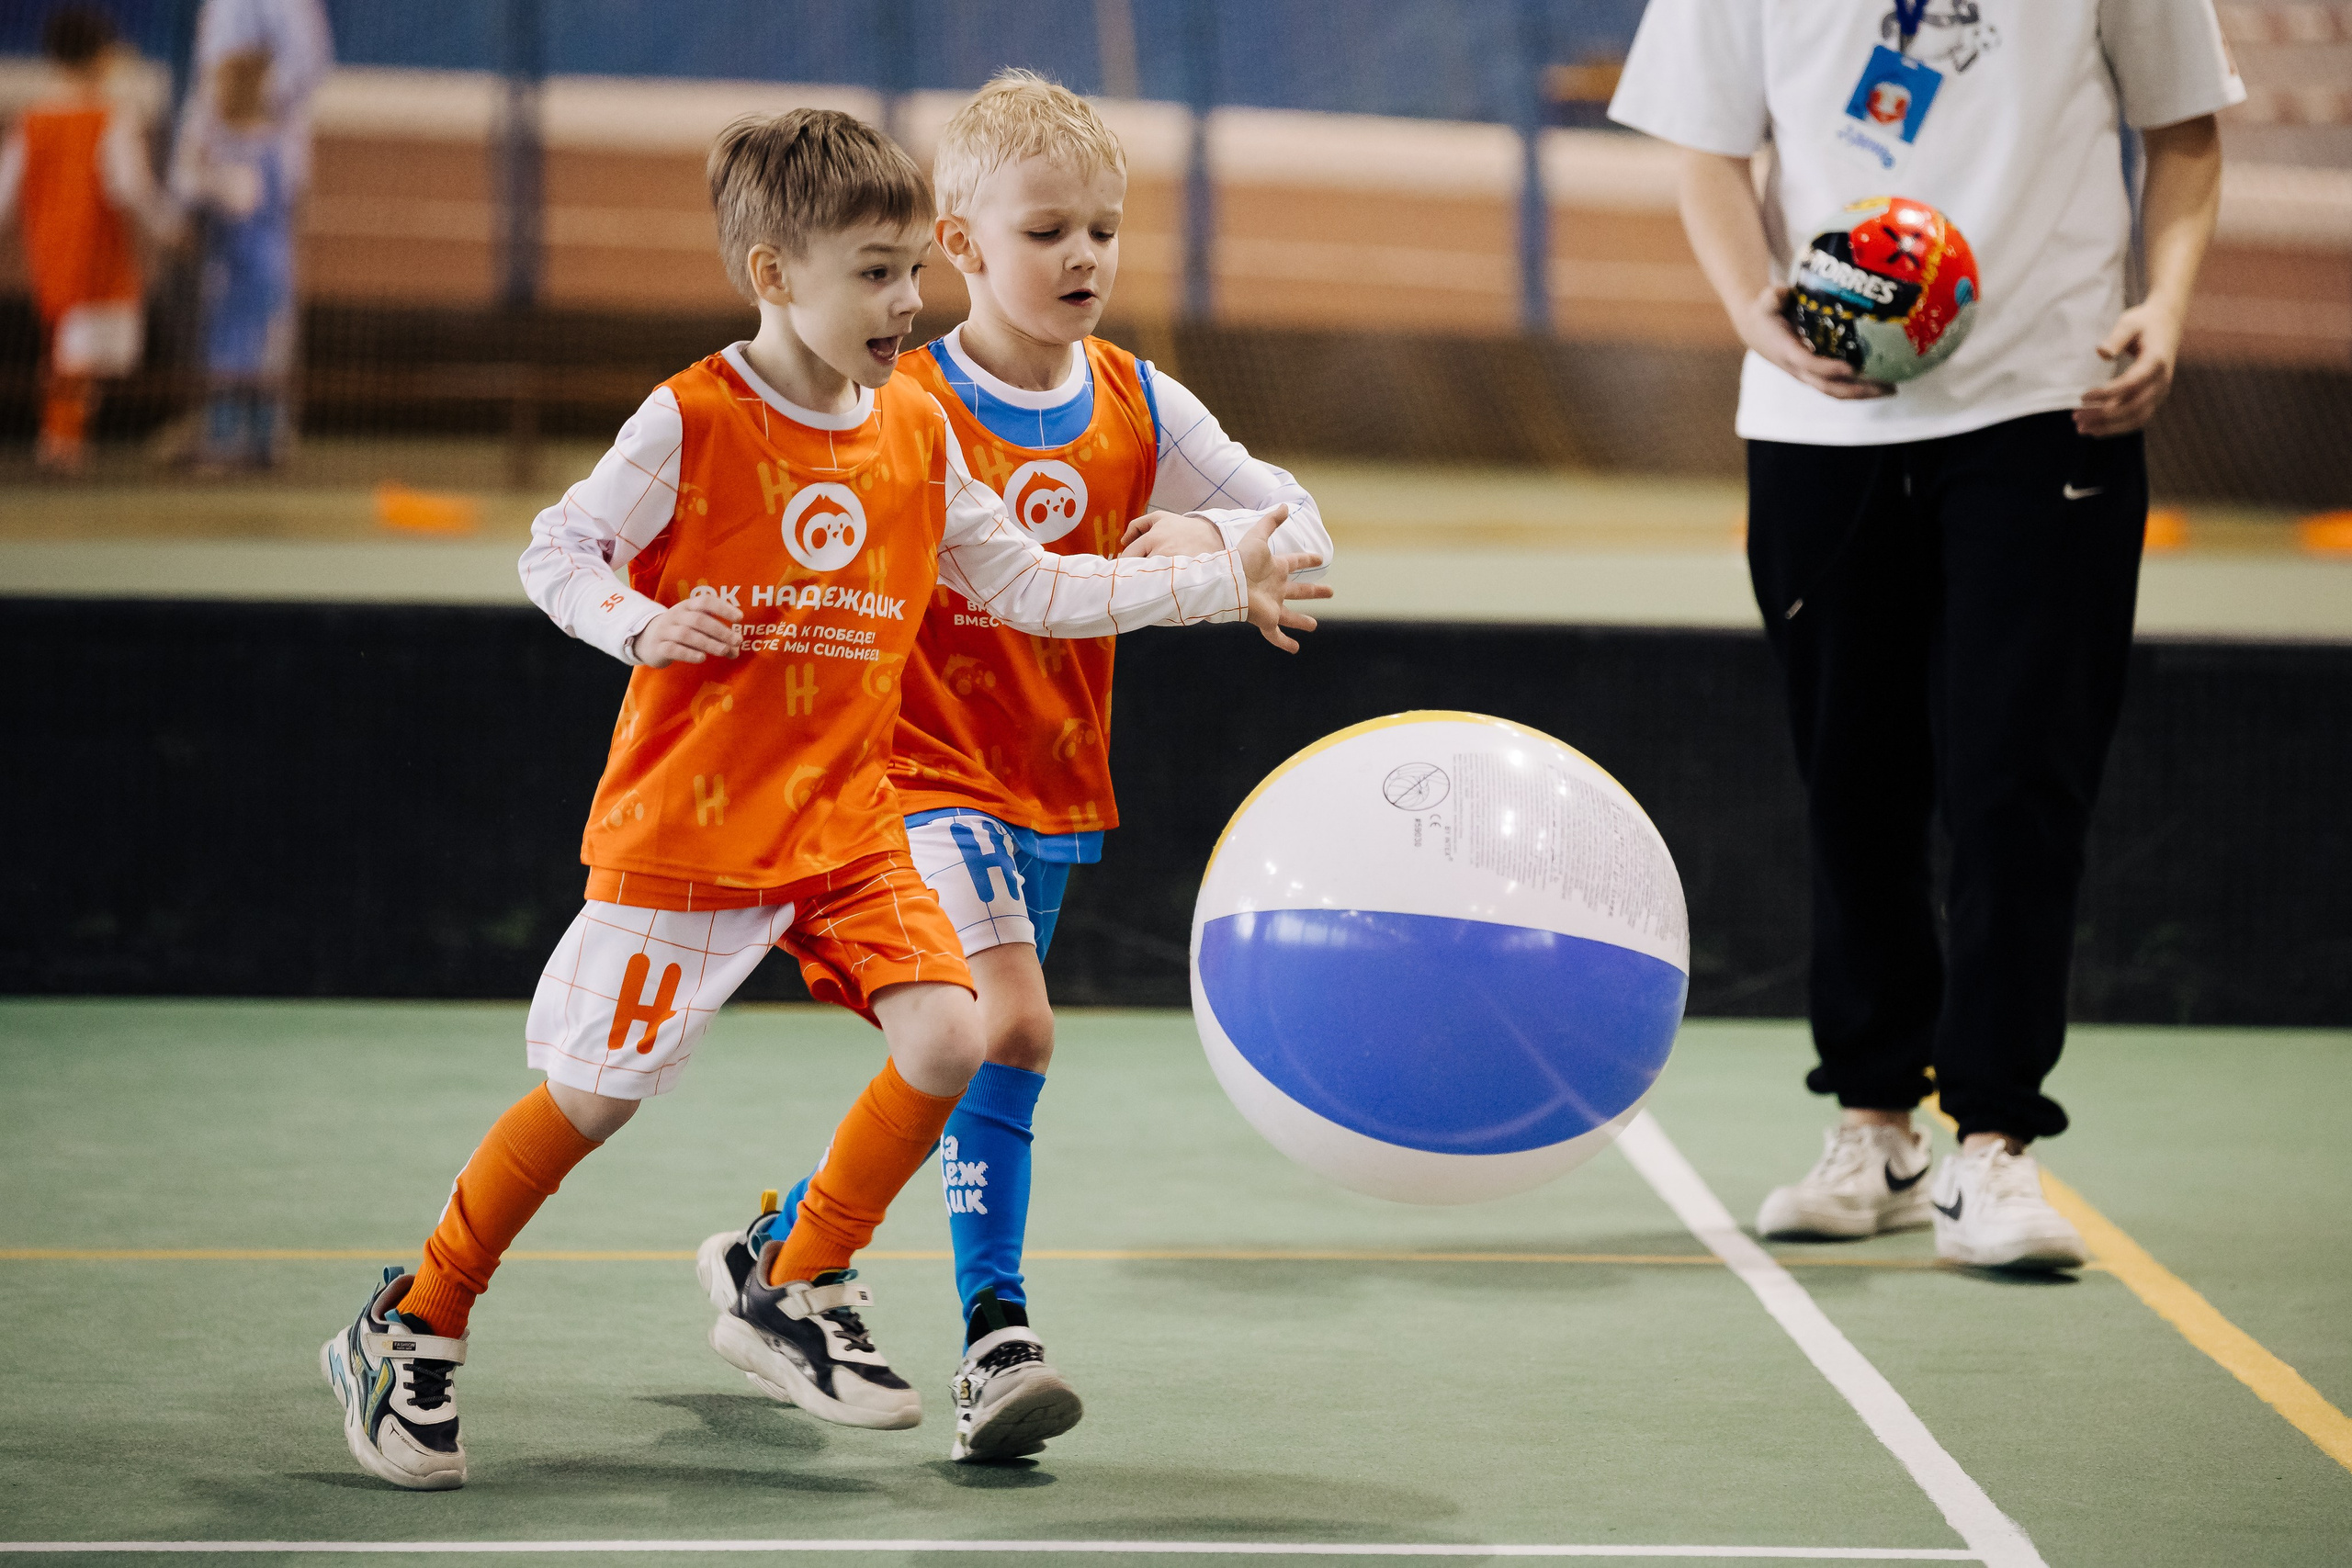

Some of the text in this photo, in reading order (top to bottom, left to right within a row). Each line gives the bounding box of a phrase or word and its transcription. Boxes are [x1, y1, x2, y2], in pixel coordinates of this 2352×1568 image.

[600, 592, 625, 613] 35
[751, 584, 907, 621] НАДЕЖДИК
[731, 621, 876, 645] ВПЕРЁД К ПОБЕДЕ!
[954, 614, 1005, 628] ВМЕС
[738, 638, 880, 661] ЕСТЕ МЫ СИЛЬНЕЕ!
[940, 1133, 959, 1161] а
[943, 1161, 989, 1190] еж
[946, 1189, 989, 1218] ик
